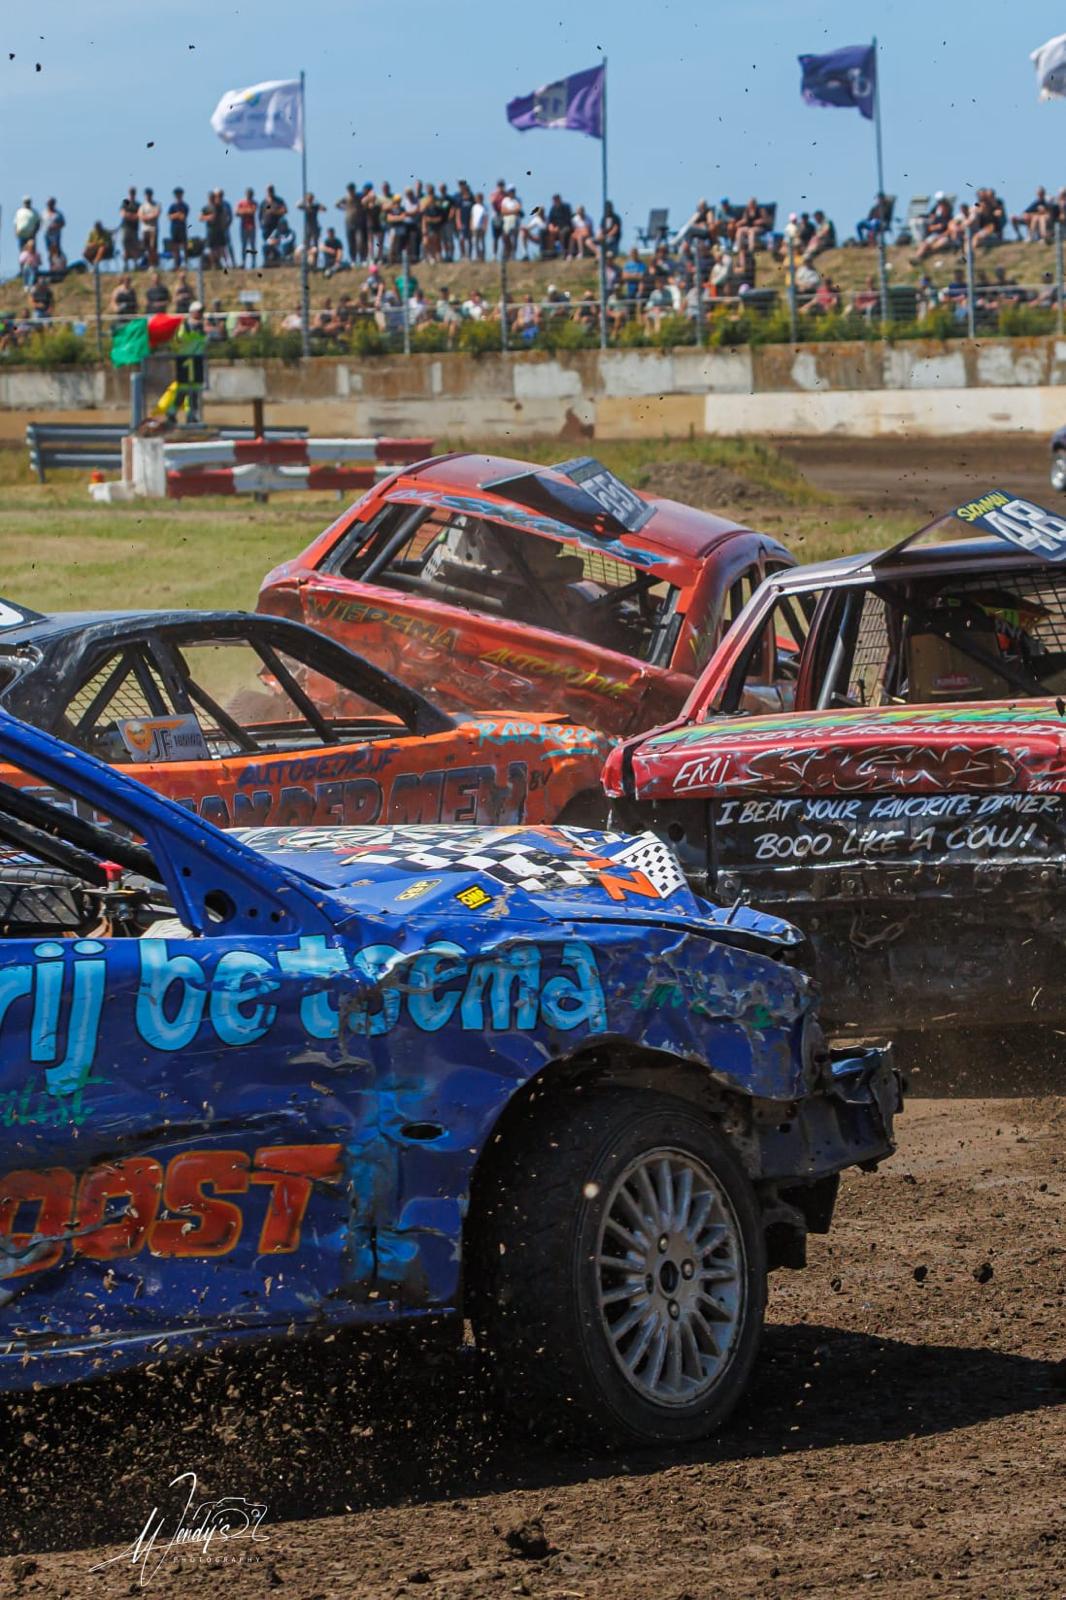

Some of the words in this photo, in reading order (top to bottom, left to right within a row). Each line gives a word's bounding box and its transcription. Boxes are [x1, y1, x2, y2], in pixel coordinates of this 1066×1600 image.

[983, 499, 1066, 552] 48
[738, 799, 803, 825] BEAT
[803, 798, 862, 821] YOUR
[869, 794, 979, 819] FAVORITE
[753, 832, 833, 860] BOOO
[842, 827, 905, 854] LIKE
[909, 826, 936, 851] A
[946, 822, 1038, 850] COW!
[461, 889, 487, 906] OMP
